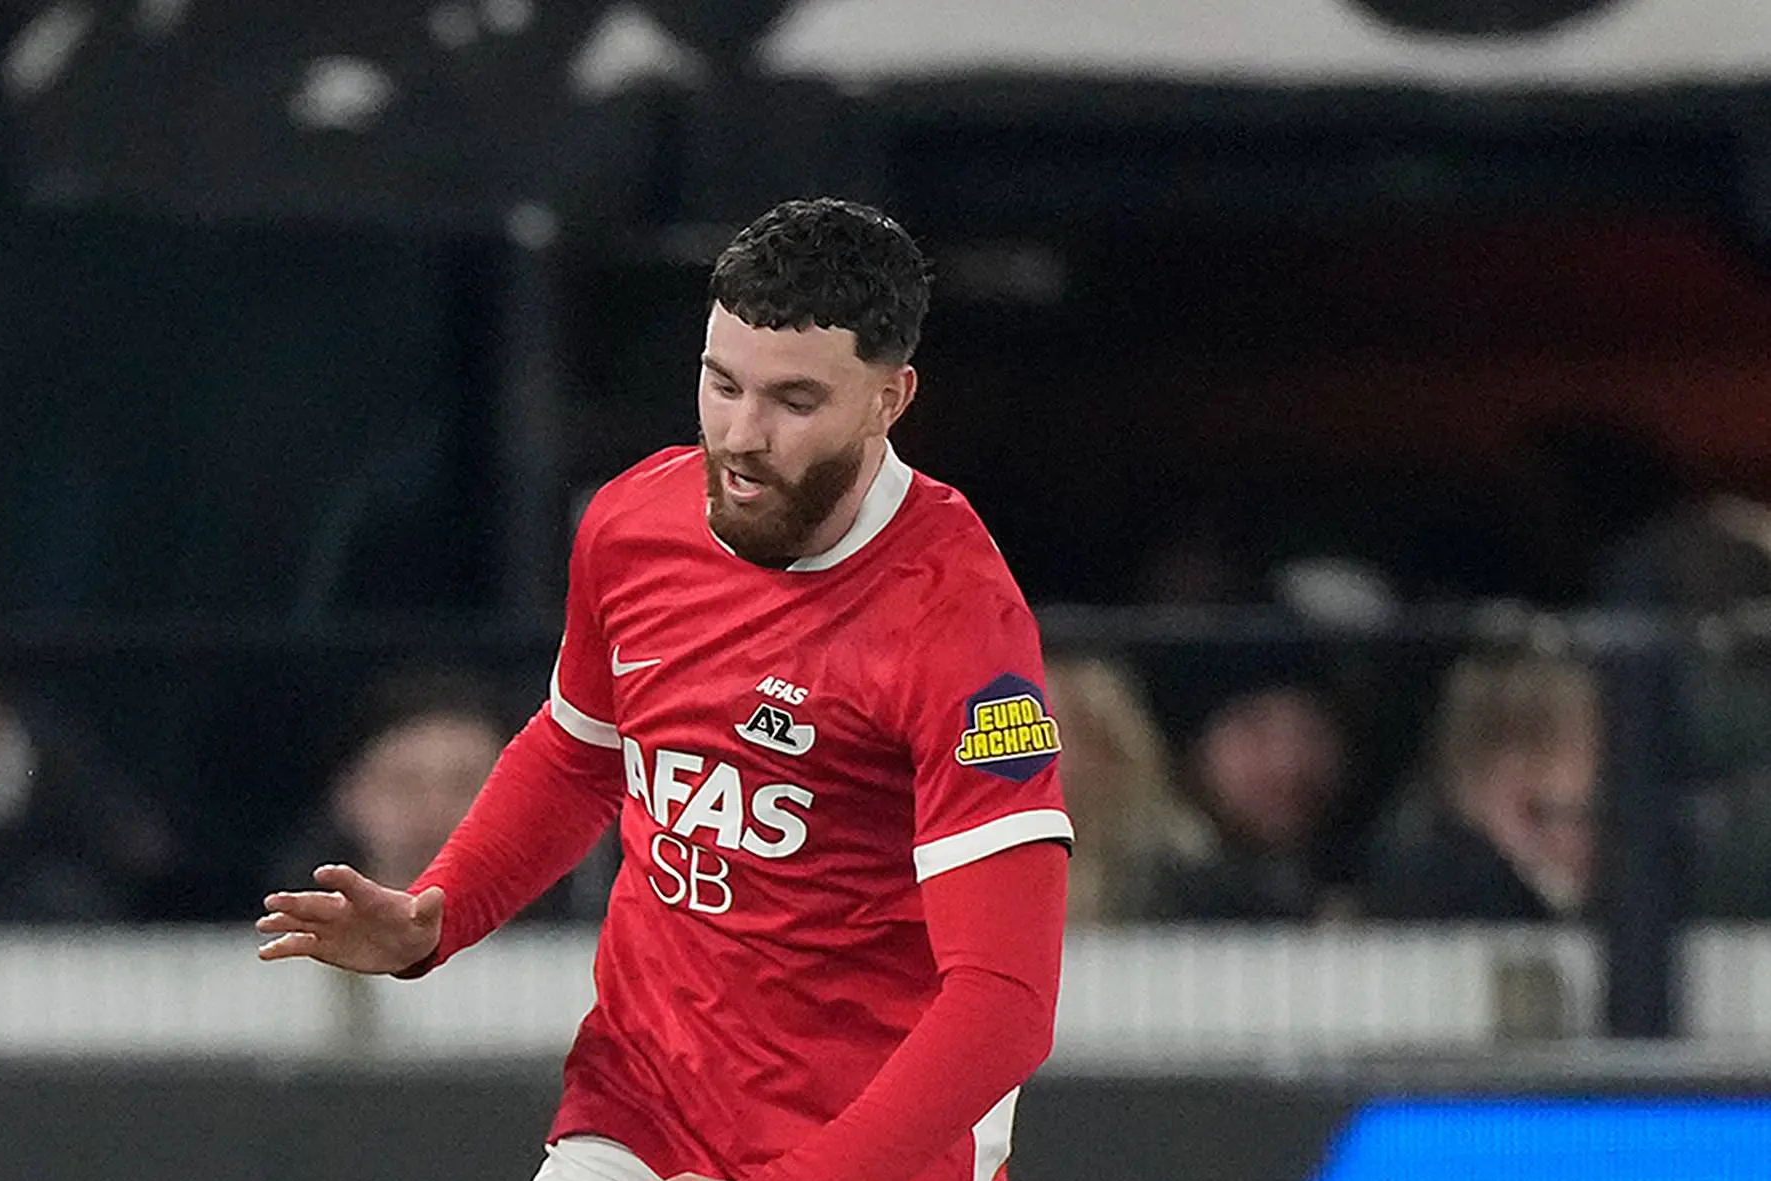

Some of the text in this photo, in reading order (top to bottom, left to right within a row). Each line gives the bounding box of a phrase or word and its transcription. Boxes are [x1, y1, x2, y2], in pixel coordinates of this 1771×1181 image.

[756, 677, 808, 706] AFAS
[746, 706, 797, 747] AZ
[979, 699, 1034, 732] EURO
[623, 737, 814, 858] AFAS
[648, 833, 732, 914] SB
